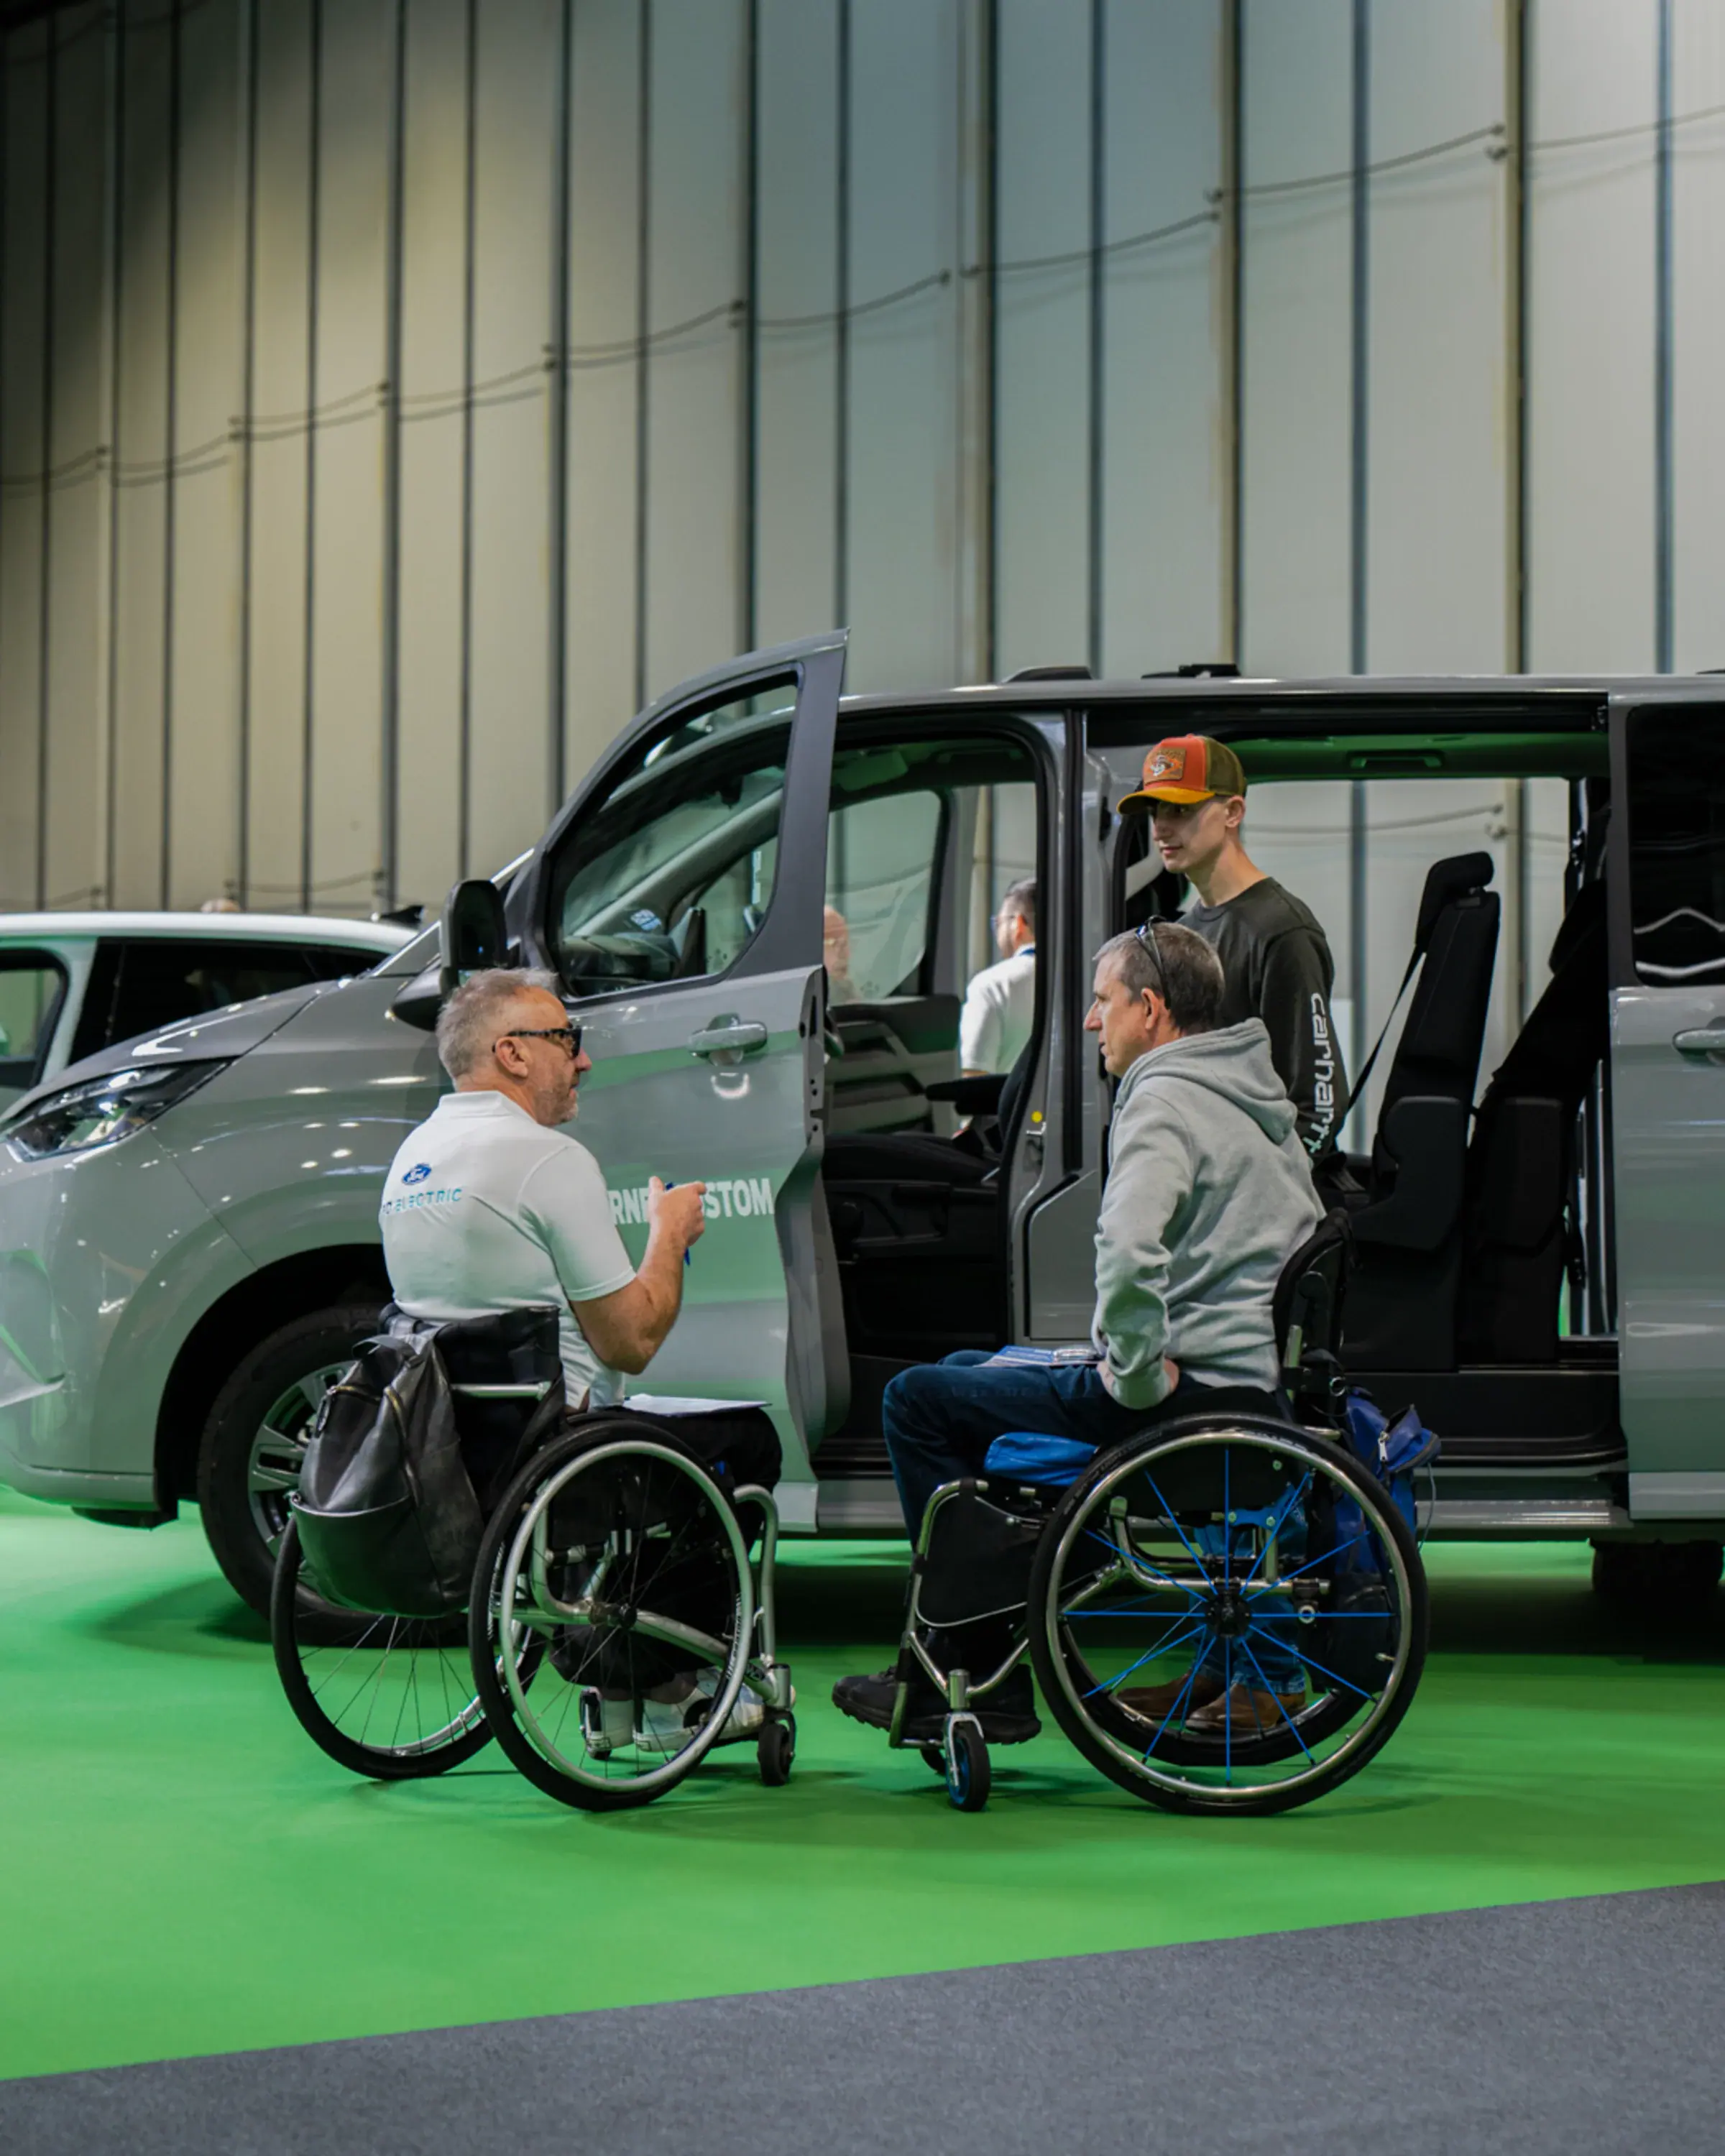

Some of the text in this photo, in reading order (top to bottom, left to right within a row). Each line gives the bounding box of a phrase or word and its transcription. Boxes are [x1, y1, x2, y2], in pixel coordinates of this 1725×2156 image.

[1302, 992, 1335, 1153] carhartt
[395, 1188, 462, 1212] ELECTRIC
[702, 1178, 775, 1219] STOM
